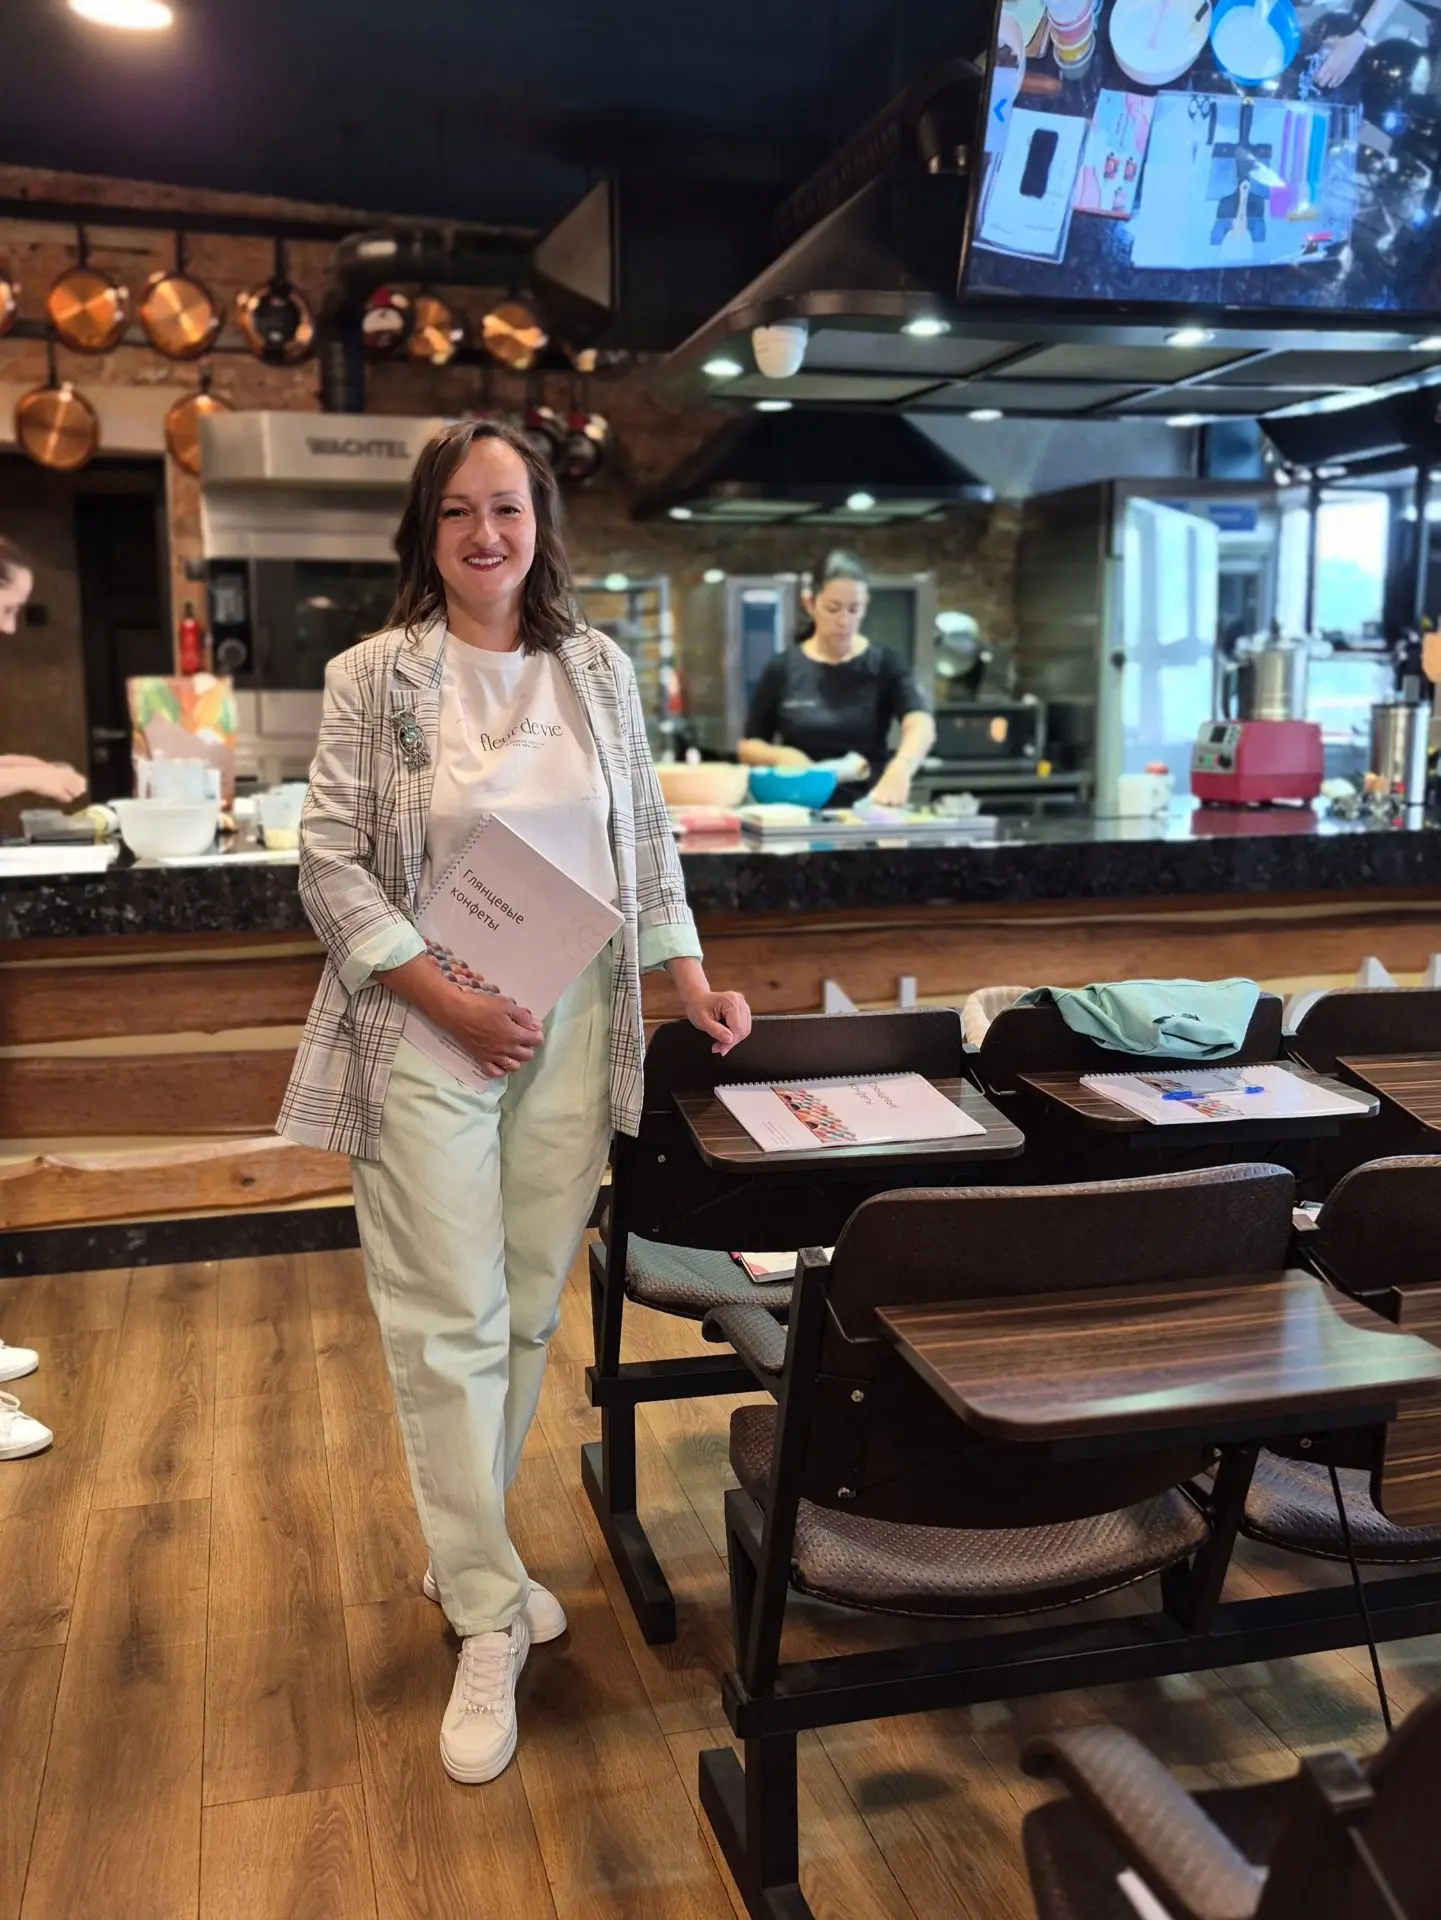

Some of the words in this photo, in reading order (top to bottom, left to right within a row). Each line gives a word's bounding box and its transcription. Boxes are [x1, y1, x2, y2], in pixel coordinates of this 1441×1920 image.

[305, 437, 411, 459] WACHTEL
[520, 717, 540, 736] de
[450, 887, 500, 932] конфеты
[463, 869, 524, 925] Глянцевые
